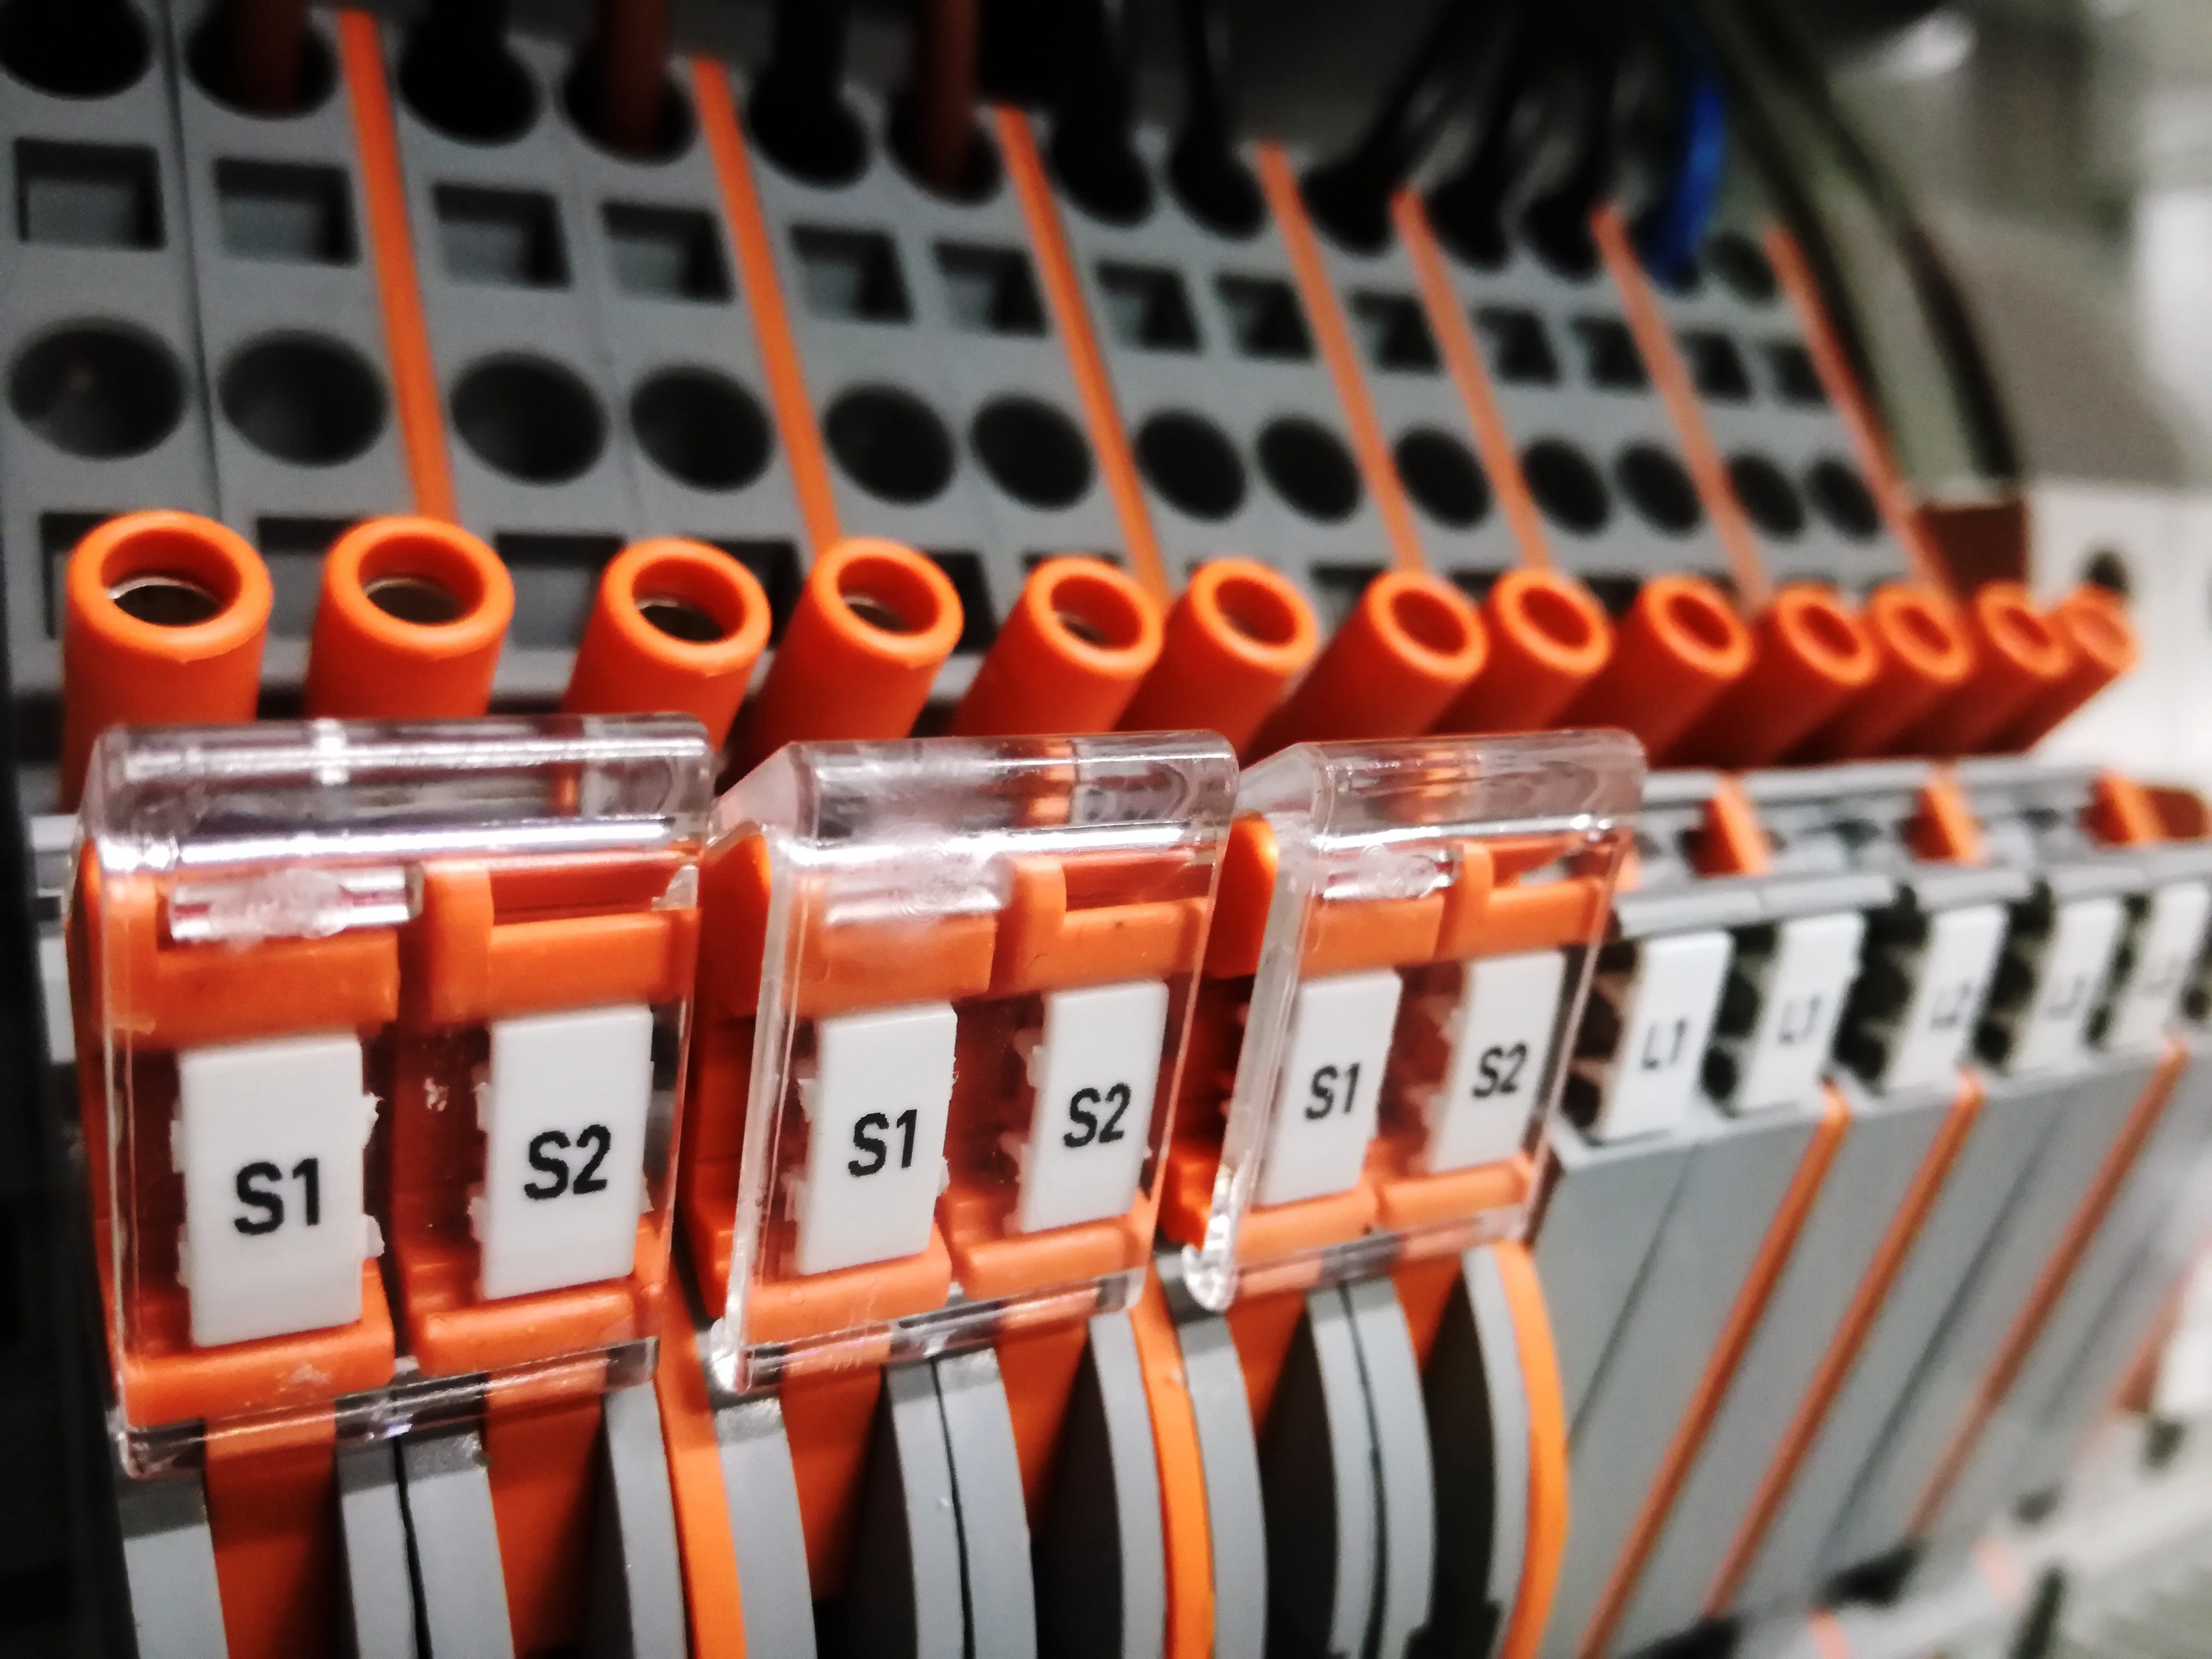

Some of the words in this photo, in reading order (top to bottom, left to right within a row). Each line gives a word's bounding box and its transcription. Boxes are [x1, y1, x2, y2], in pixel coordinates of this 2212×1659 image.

[1640, 1017, 1688, 1071] L1
[1777, 993, 1823, 1045] L1
[1304, 1062, 1361, 1120] S1
[1471, 1042, 1528, 1099] S2
[847, 1108, 918, 1178] S1
[1062, 1082, 1132, 1149] S2
[523, 1123, 612, 1202] S2
[233, 1157, 321, 1237] S1
